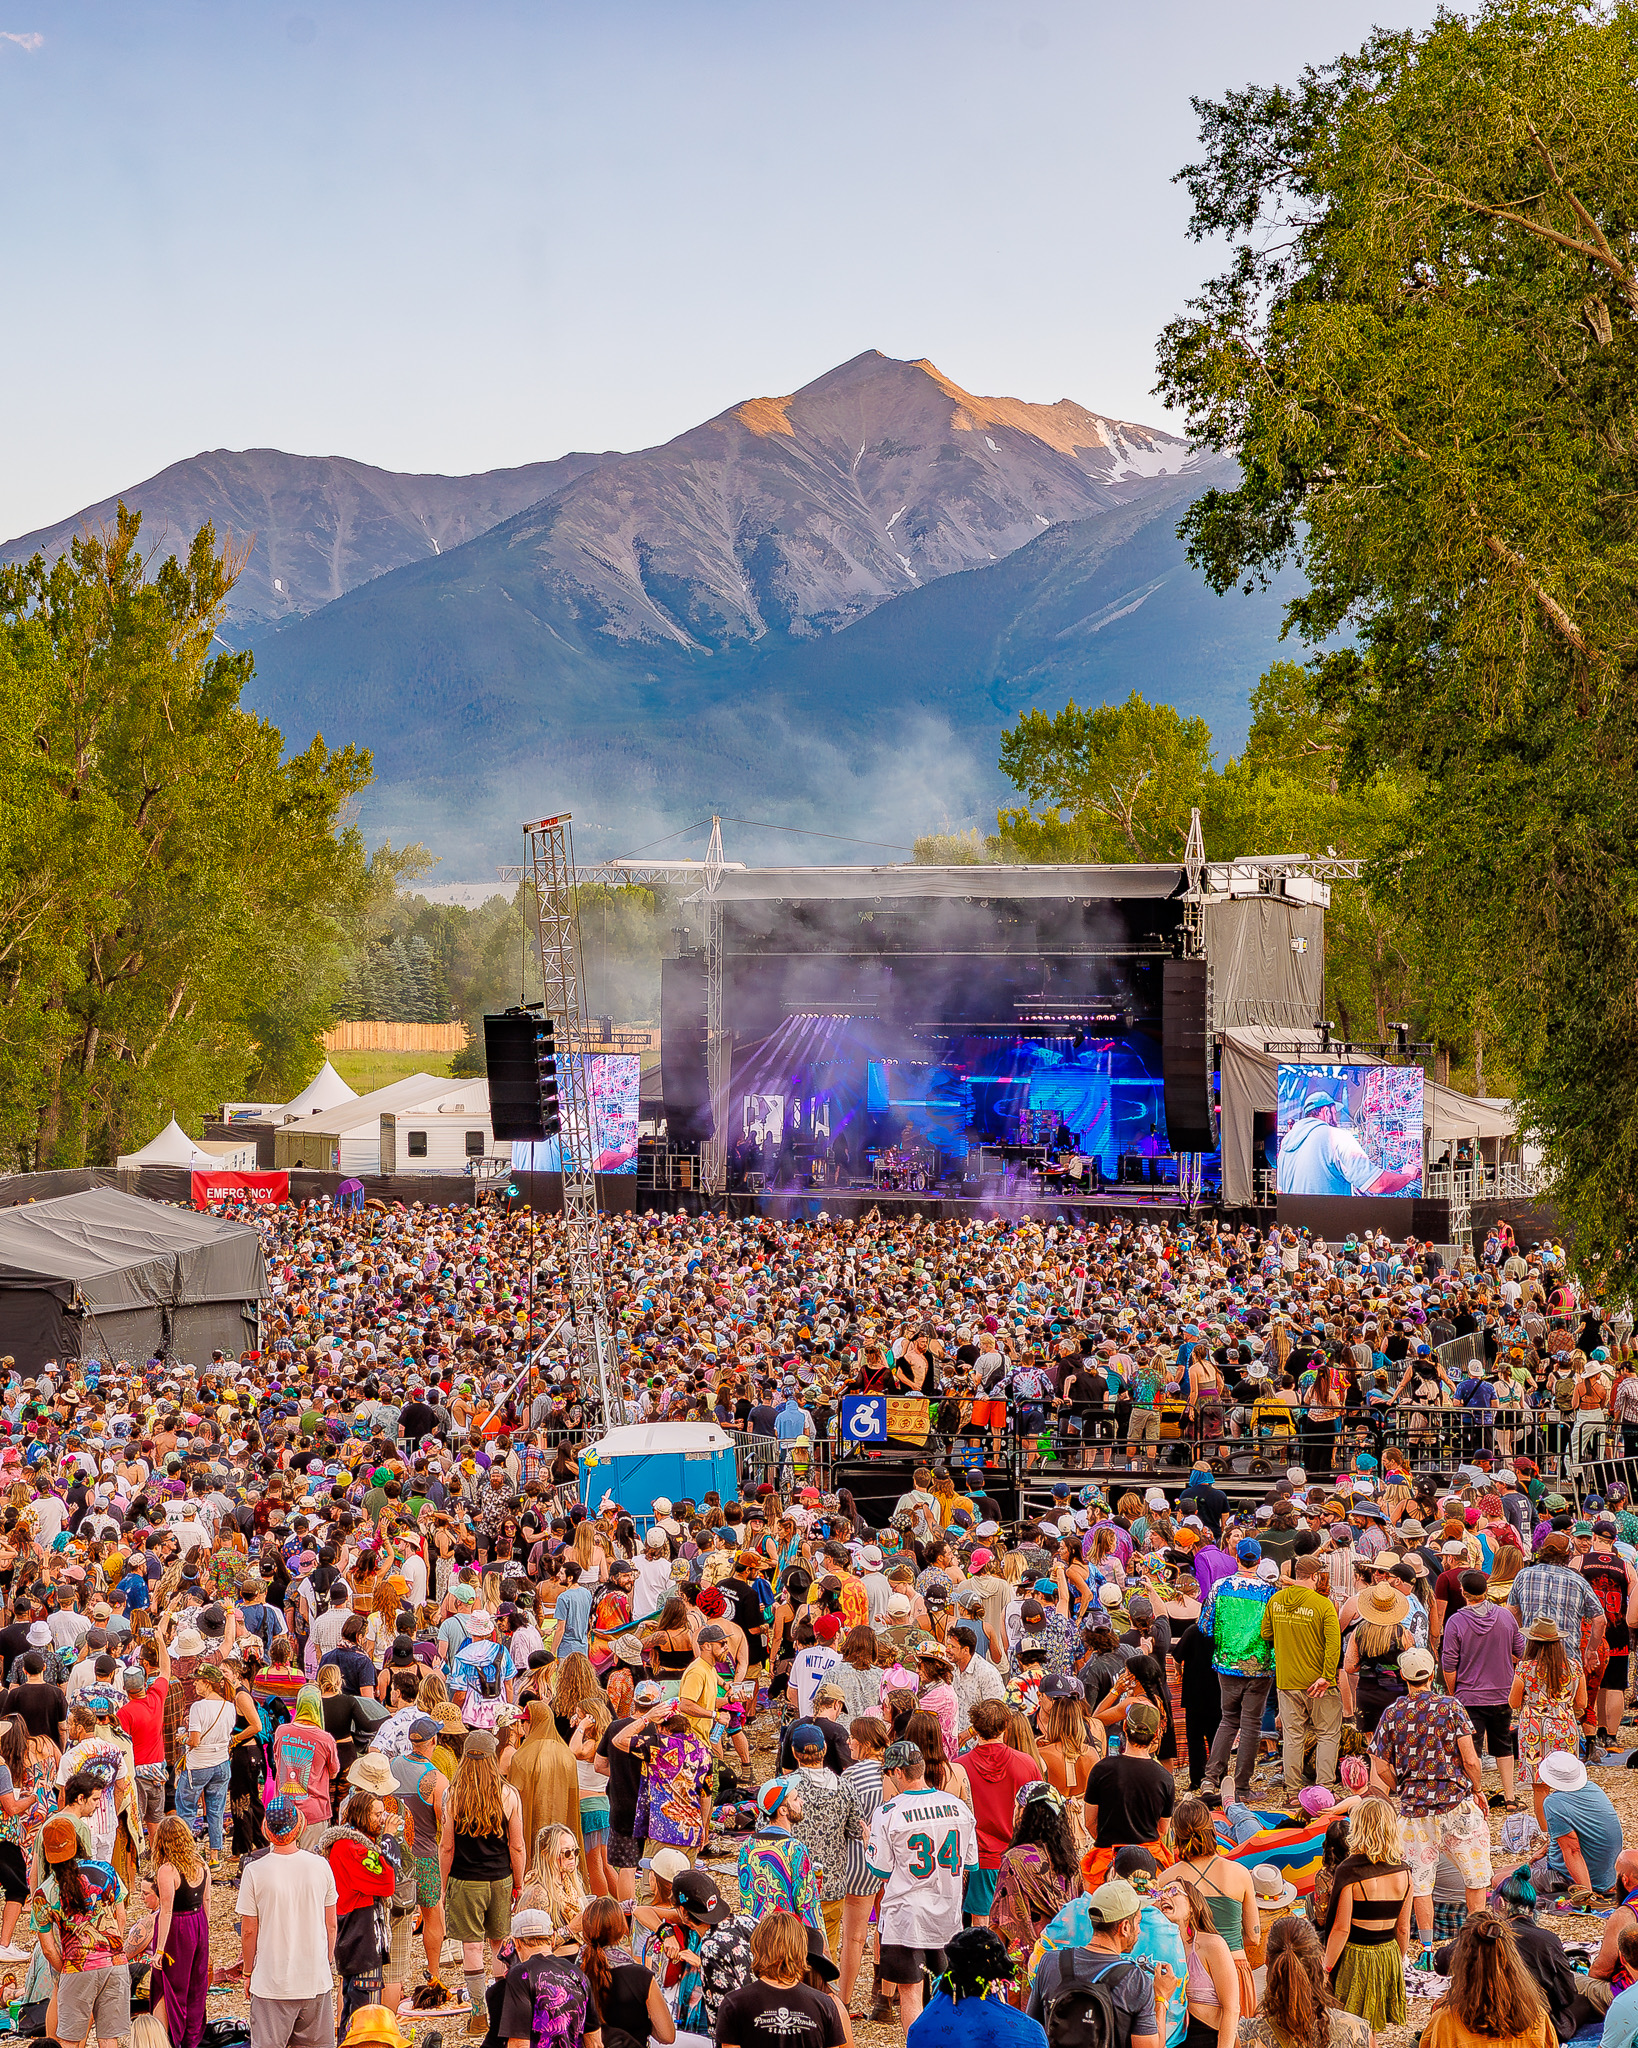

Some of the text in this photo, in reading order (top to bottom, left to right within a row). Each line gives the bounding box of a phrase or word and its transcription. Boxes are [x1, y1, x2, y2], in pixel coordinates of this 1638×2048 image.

[206, 1187, 273, 1199] EMERGNCY
[805, 1655, 823, 1669] WITT
[808, 1672, 824, 1701] 7
[902, 1804, 960, 1824] WILLIAMS
[906, 1829, 963, 1880] 34
